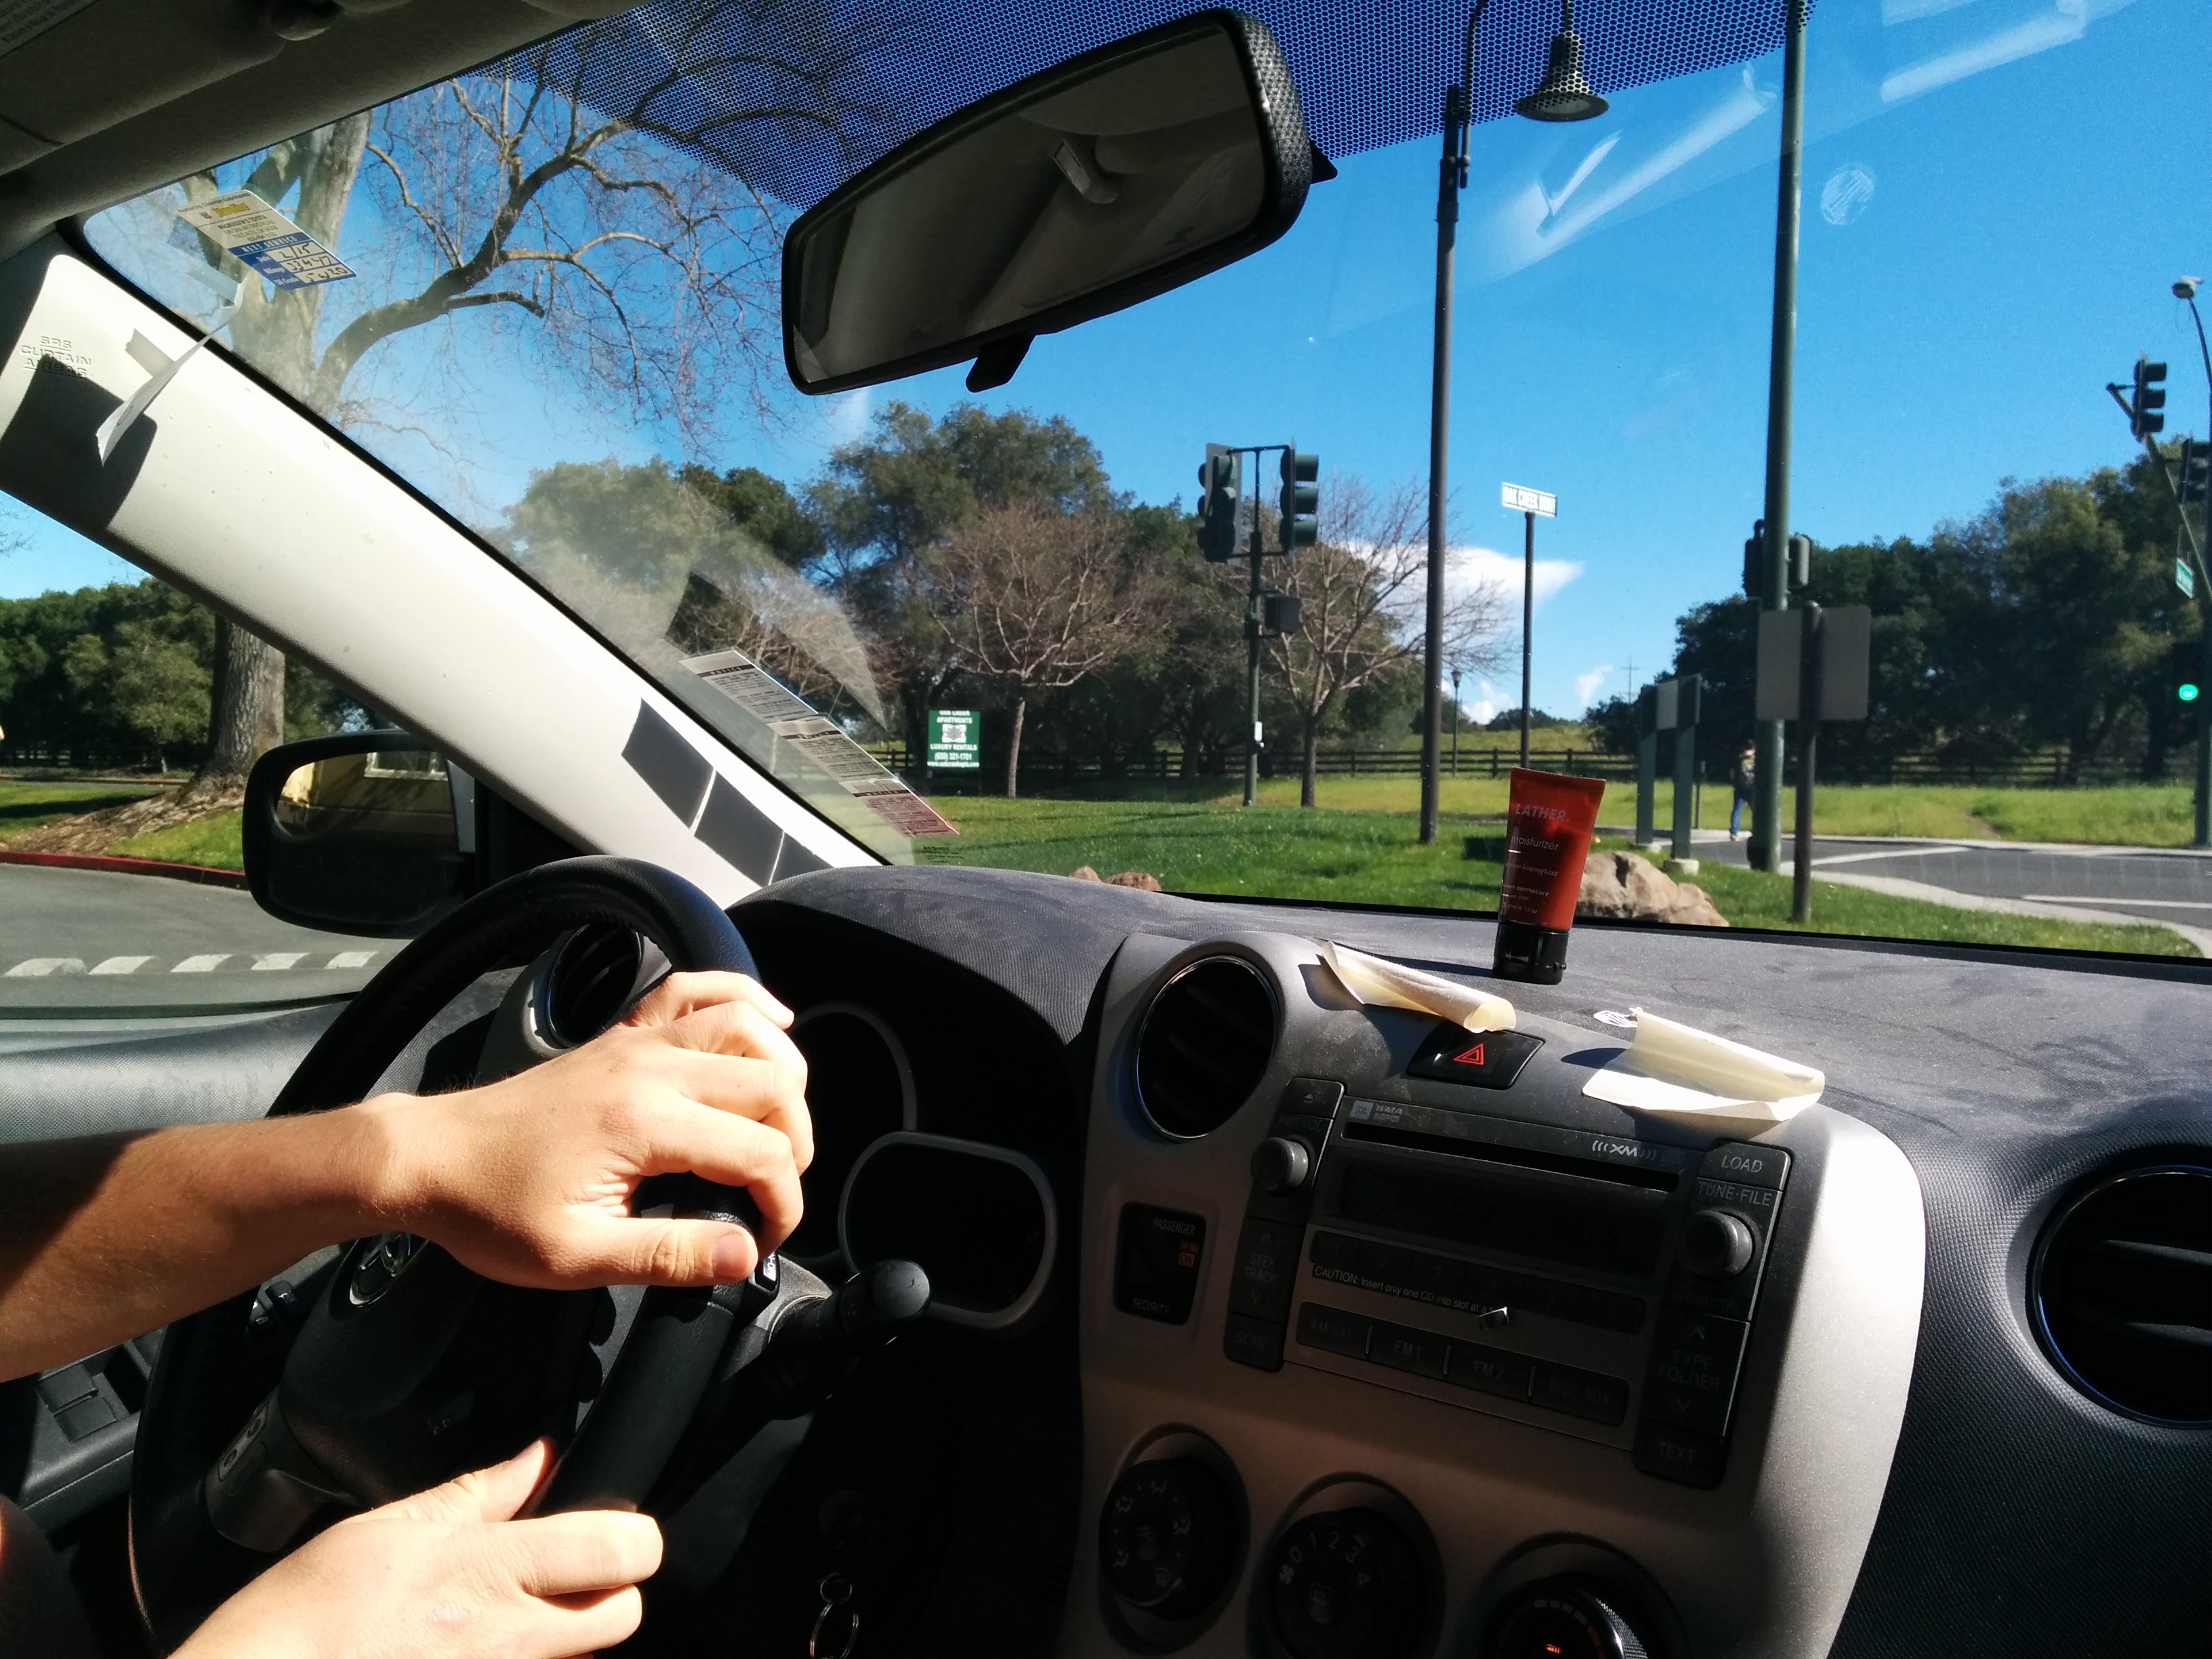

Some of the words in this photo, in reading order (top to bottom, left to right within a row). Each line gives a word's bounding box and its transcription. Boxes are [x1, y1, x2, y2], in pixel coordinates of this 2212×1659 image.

[241, 244, 264, 253] NEXT
[263, 235, 298, 247] SERVICE
[41, 335, 72, 348] SRS
[22, 345, 92, 366] CURTAIN
[710, 666, 742, 675] NOTICE
[1511, 836, 1559, 851] moisturizer
[1521, 863, 1558, 876] lemongrass
[1516, 886, 1549, 897] apothecary
[1375, 1103, 1402, 1115] WMA
[1721, 1155, 1763, 1173] LOAD
[1153, 1217, 1196, 1236] PASSENGER
[1250, 1252, 1275, 1267] SEEK
[1245, 1266, 1278, 1285] TRACK
[1315, 1266, 1359, 1286] CAUTION:
[1361, 1277, 1384, 1292] Insert
[1385, 1284, 1401, 1296] only
[1403, 1288, 1418, 1299] one
[1420, 1291, 1434, 1303] CD
[1436, 1296, 1452, 1307] into
[1454, 1298, 1469, 1311] slot
[1470, 1303, 1480, 1313] at
[1132, 1297, 1171, 1317] SECURITY
[1237, 1331, 1267, 1350] SCAN
[1675, 1349, 1714, 1372] TYPE
[1659, 1364, 1721, 1389] FOLDER
[1658, 1441, 1696, 1465] TEXT
[1309, 1532, 1317, 1549] 1
[1328, 1531, 1340, 1550] 2
[1357, 1572, 1371, 1586] 4
